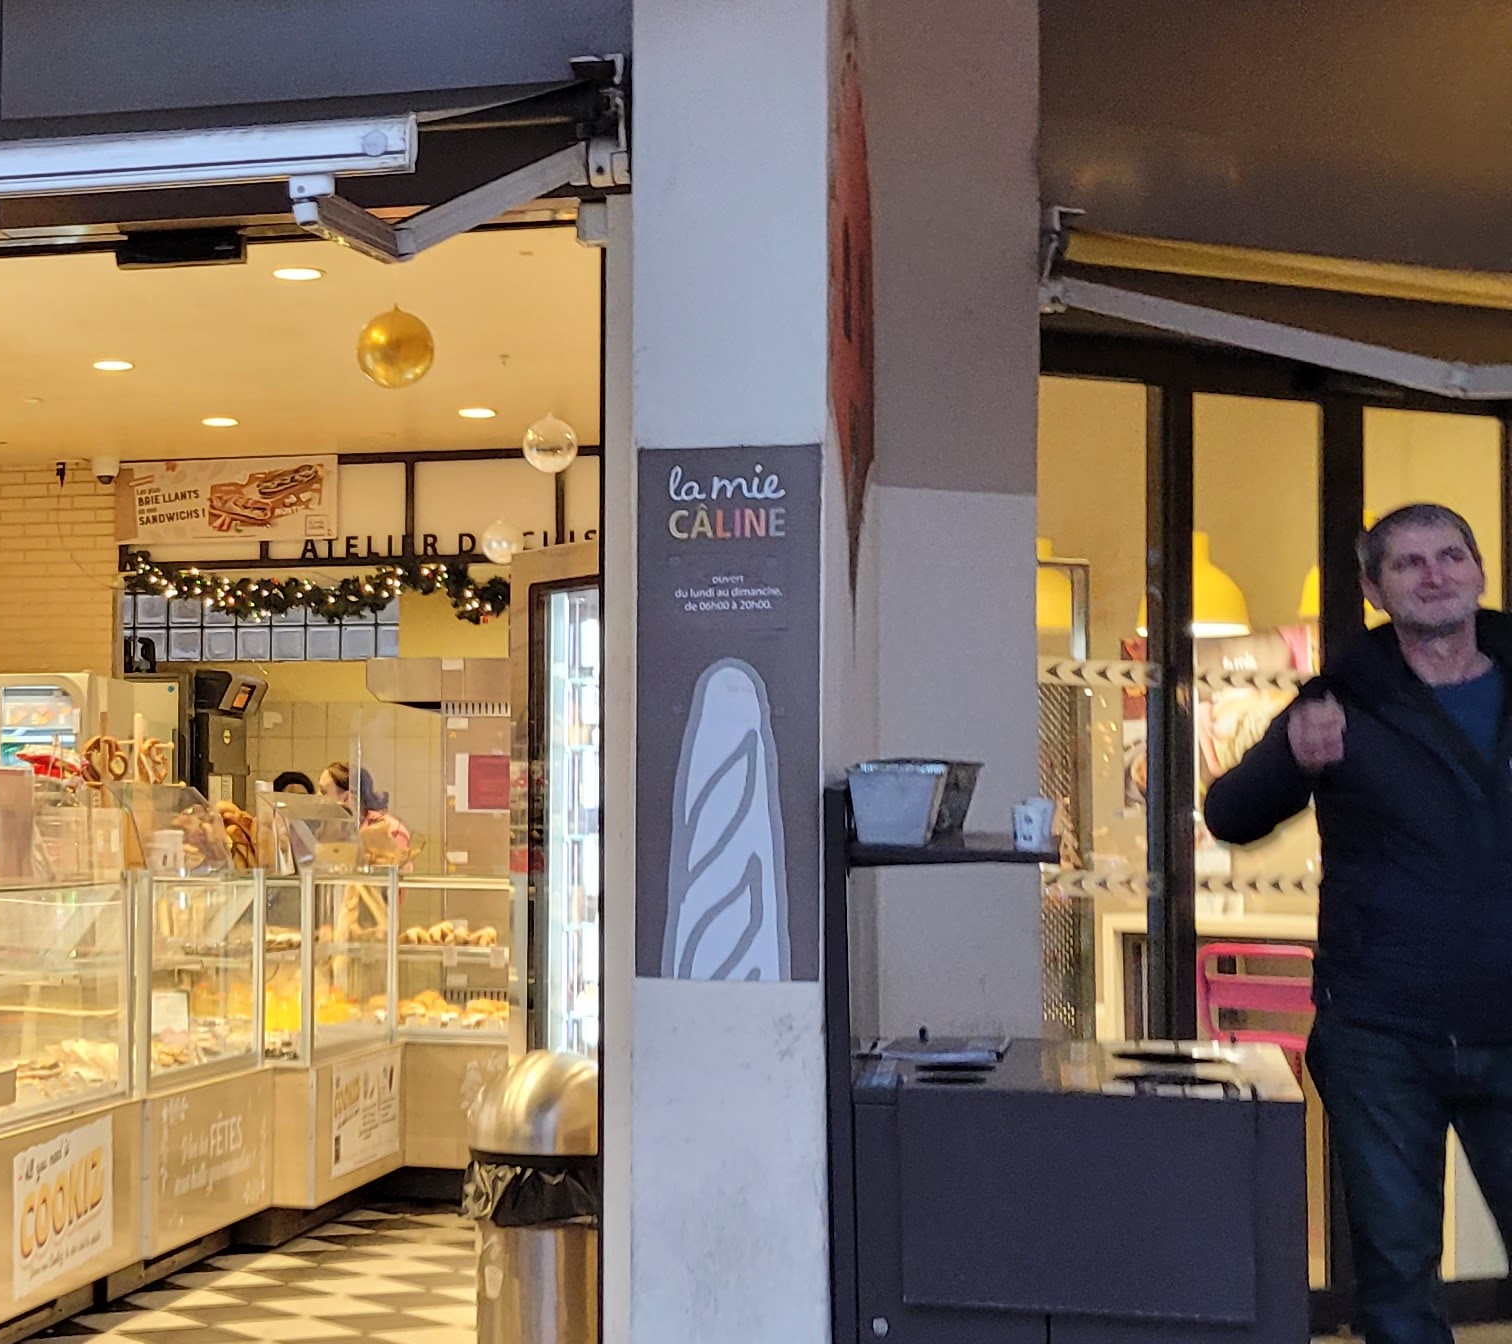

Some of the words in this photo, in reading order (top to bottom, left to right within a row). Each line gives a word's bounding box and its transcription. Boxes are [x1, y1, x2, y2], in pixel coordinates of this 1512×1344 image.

[668, 464, 705, 501] la
[711, 463, 786, 500] mie
[668, 503, 786, 540] CÂLINE
[674, 587, 688, 598] du
[690, 587, 715, 598] lundi
[717, 588, 730, 598] au
[684, 601, 698, 612] de
